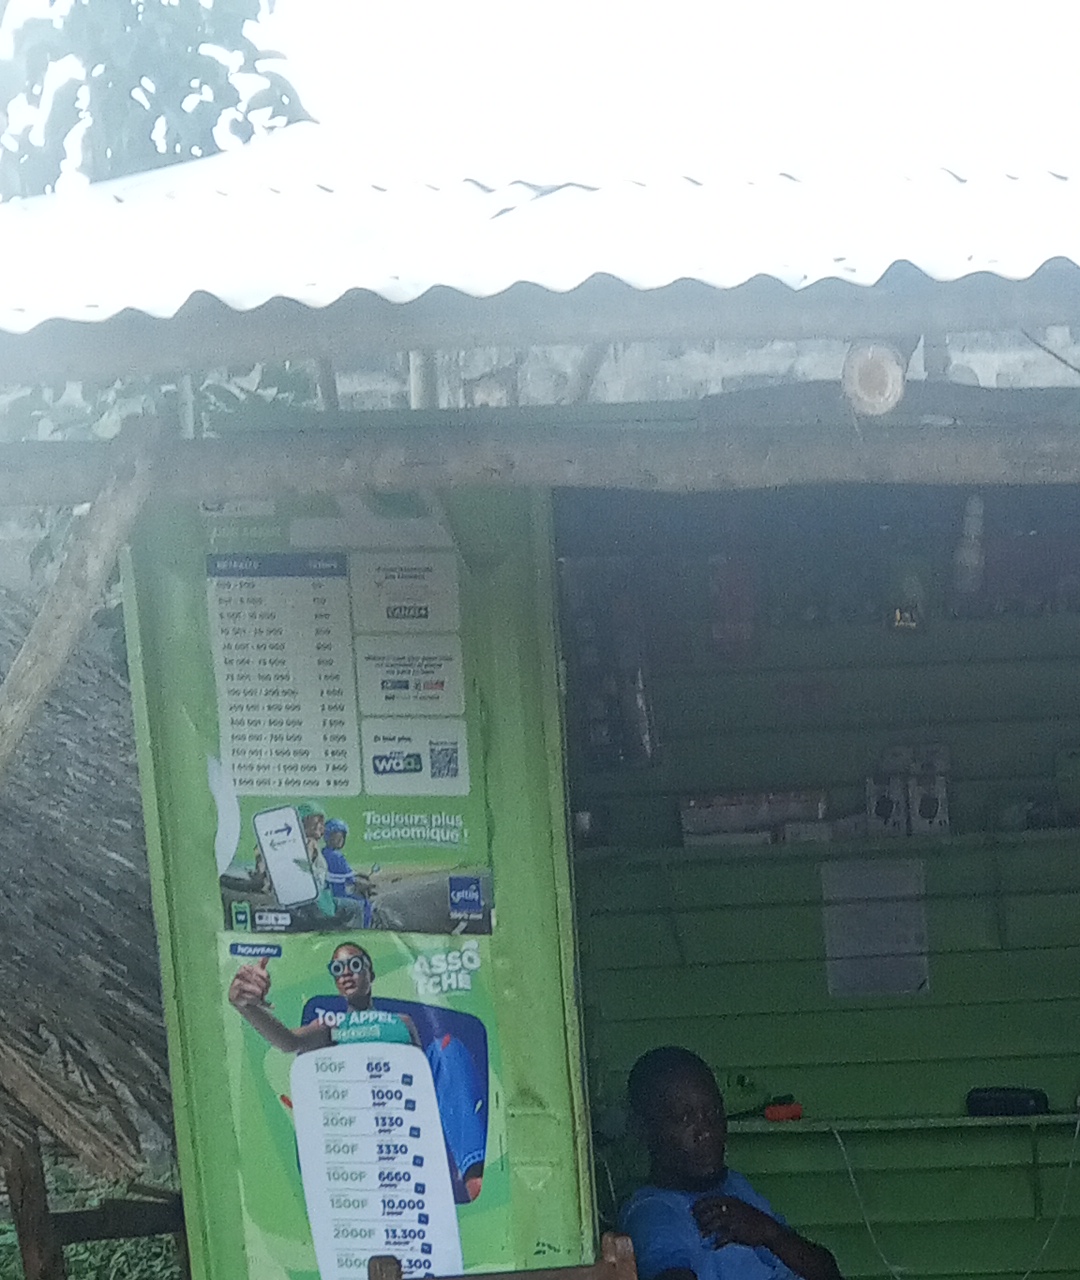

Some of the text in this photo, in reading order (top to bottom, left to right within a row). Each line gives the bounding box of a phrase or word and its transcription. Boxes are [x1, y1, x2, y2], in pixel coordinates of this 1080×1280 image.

[363, 811, 464, 826] Toujours plus
[364, 826, 460, 844] économique
[415, 950, 481, 975] ASSO
[315, 1007, 396, 1027] TOP APPEL
[314, 1061, 391, 1073] 100F 665
[371, 1089, 403, 1100] 1000
[322, 1116, 404, 1128] 200F 1330
[376, 1143, 409, 1155] 3330
[326, 1171, 411, 1182] 1000F 6660
[329, 1198, 425, 1211] 1500F 10.000
[333, 1228, 426, 1240] 2000F 13.300
[337, 1257, 368, 1269] 500
